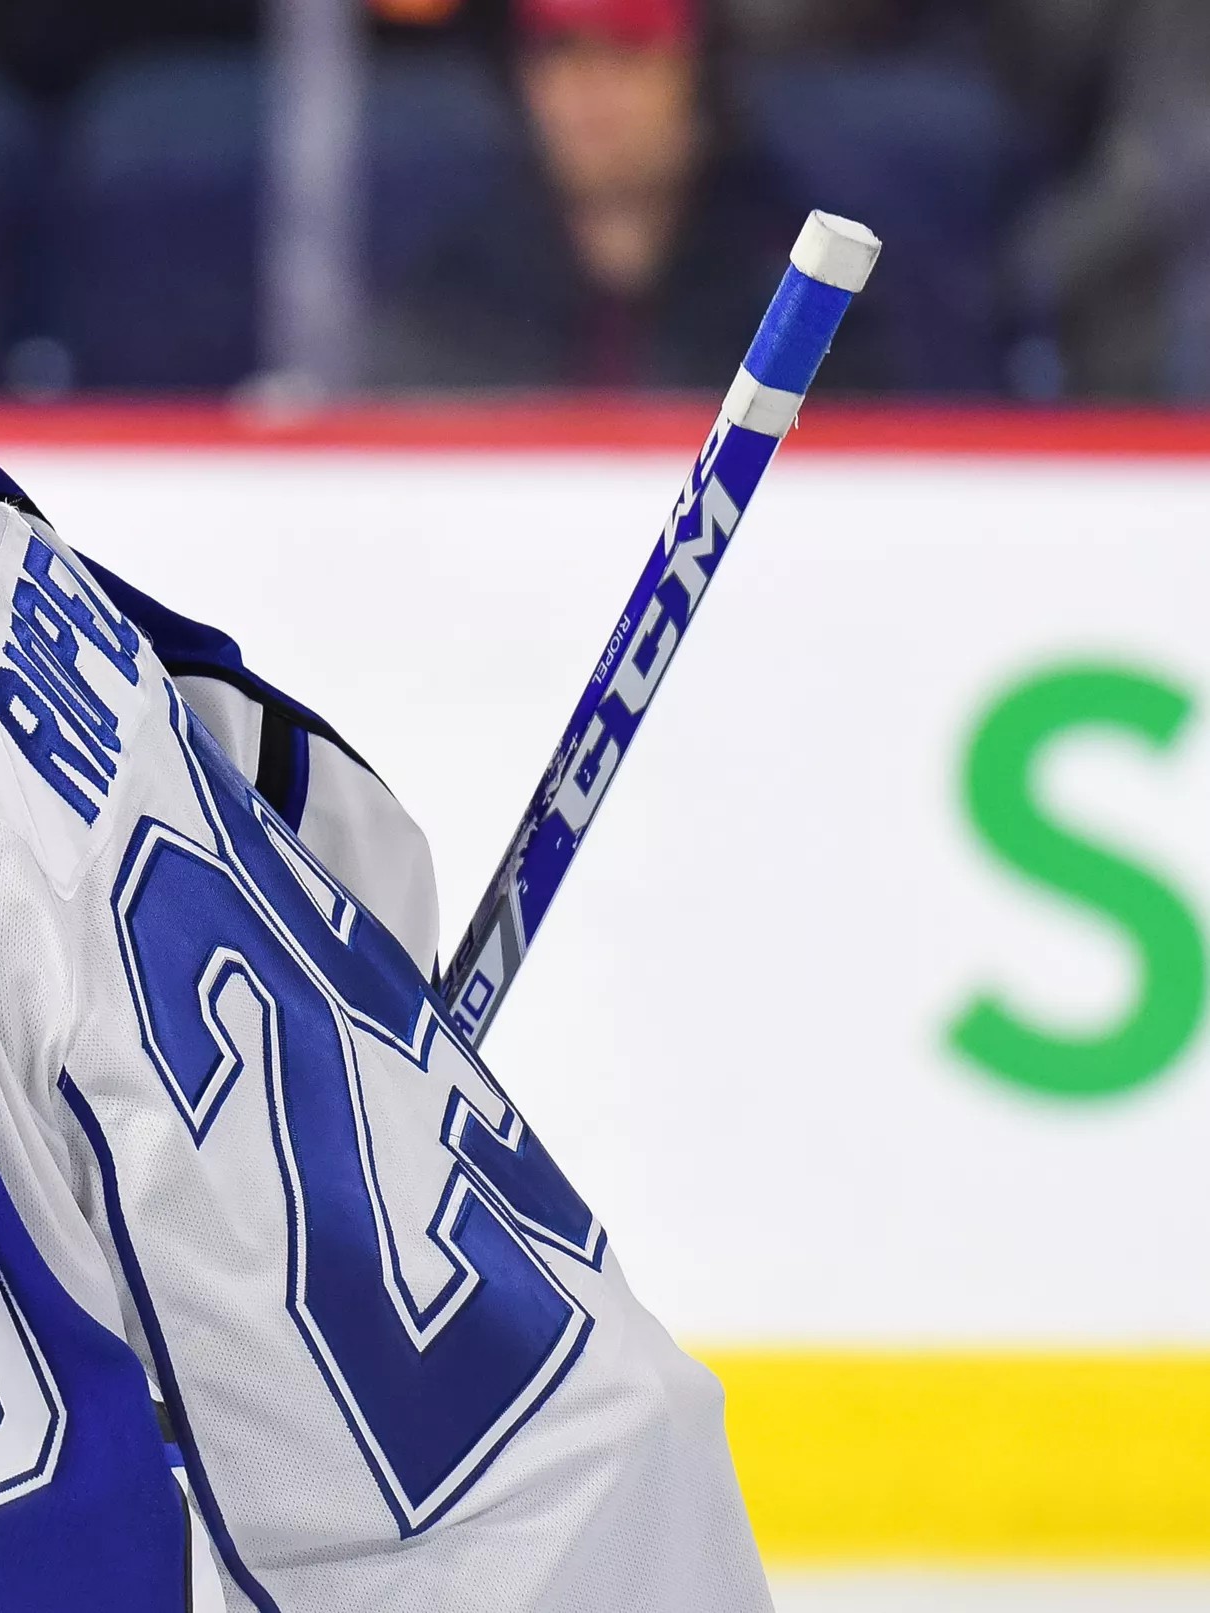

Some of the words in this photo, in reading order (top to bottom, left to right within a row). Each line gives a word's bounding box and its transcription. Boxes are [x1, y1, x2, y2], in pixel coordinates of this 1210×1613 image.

[540, 471, 742, 834] CCM
[592, 614, 631, 685] RIOPEL
[948, 662, 1207, 1100] S
[112, 677, 606, 1540] 29
